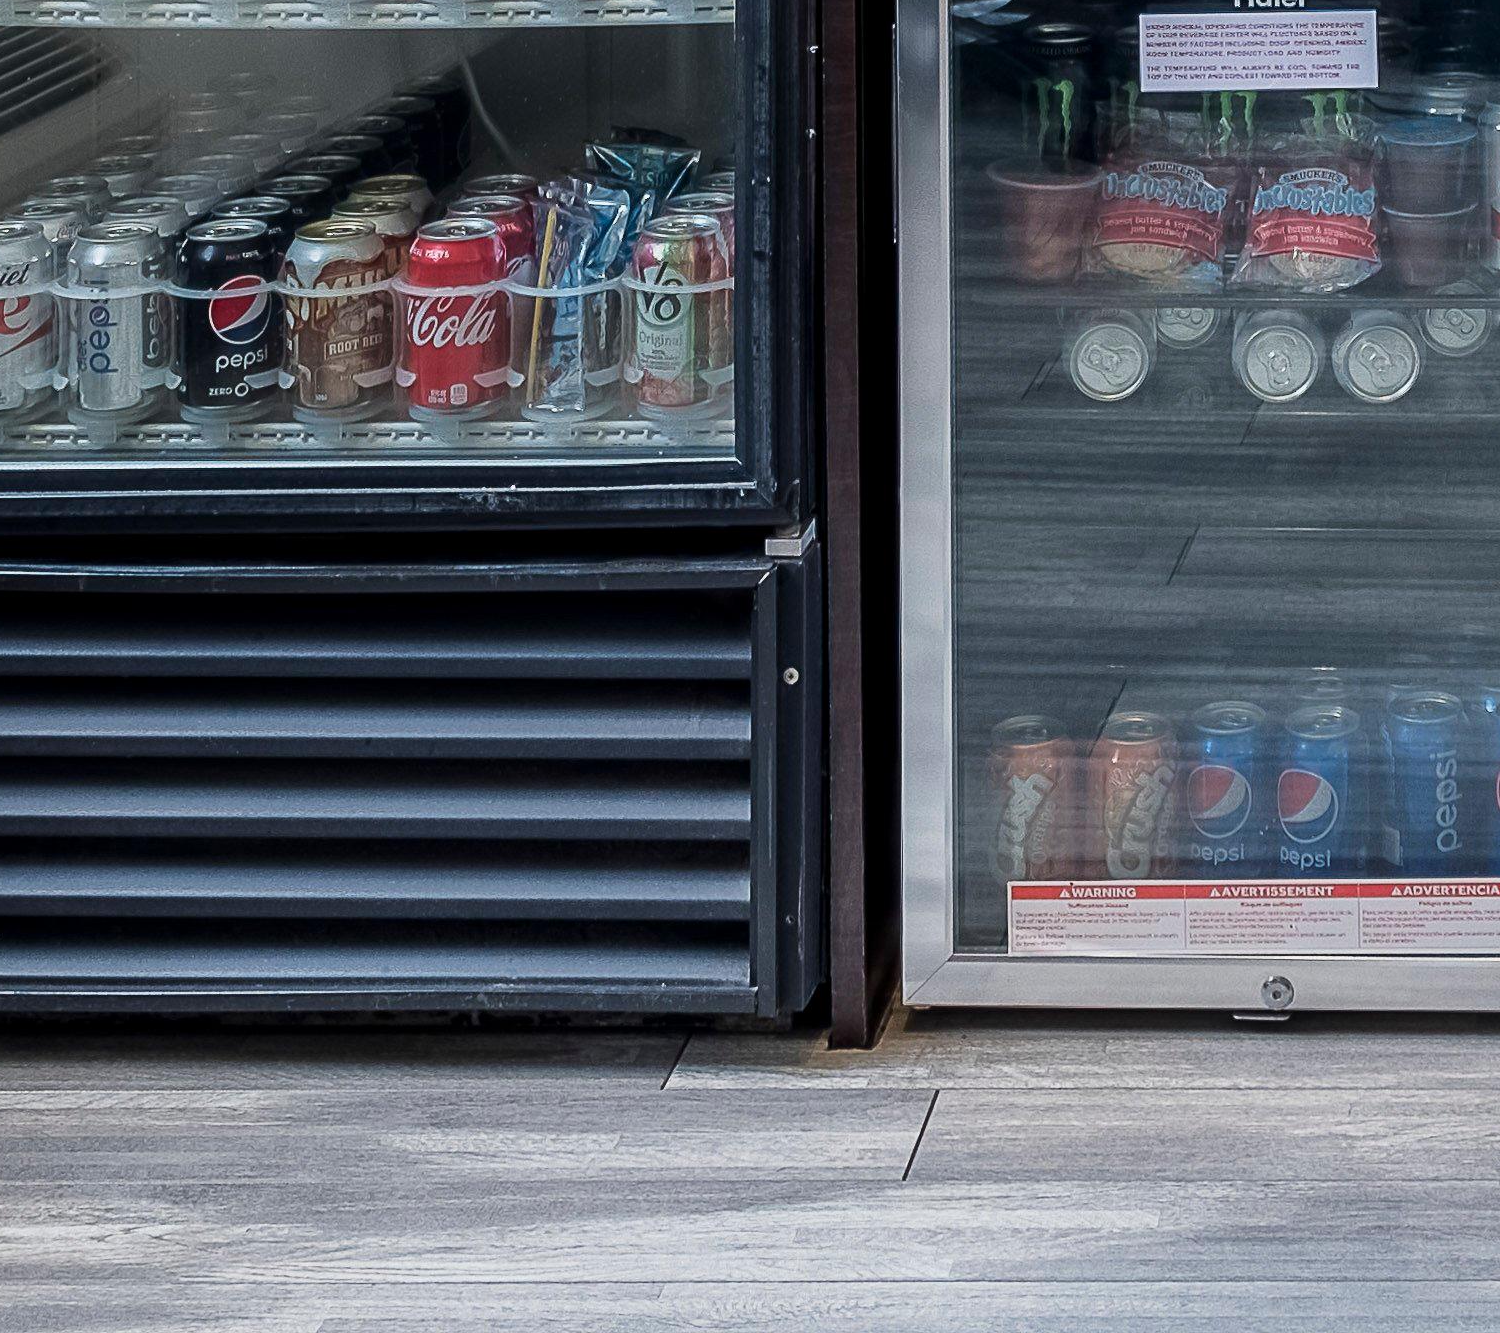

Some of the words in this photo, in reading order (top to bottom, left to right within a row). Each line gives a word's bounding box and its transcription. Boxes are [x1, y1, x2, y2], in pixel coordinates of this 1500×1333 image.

[1140, 162, 1204, 180] SMUCKER'S
[89, 279, 118, 374] pepsi
[411, 293, 495, 349] Cola
[329, 339, 361, 356] ROOT
[638, 331, 684, 351] Original
[216, 347, 268, 373] pepsi
[209, 387, 233, 397] ZERO
[1436, 748, 1463, 853] pepsi
[1280, 846, 1332, 871] pepsi
[1072, 887, 1136, 898] WARNING
[1222, 886, 1334, 897] AVERTISSEMENT
[1404, 884, 1500, 896] ADVERTENCIA
